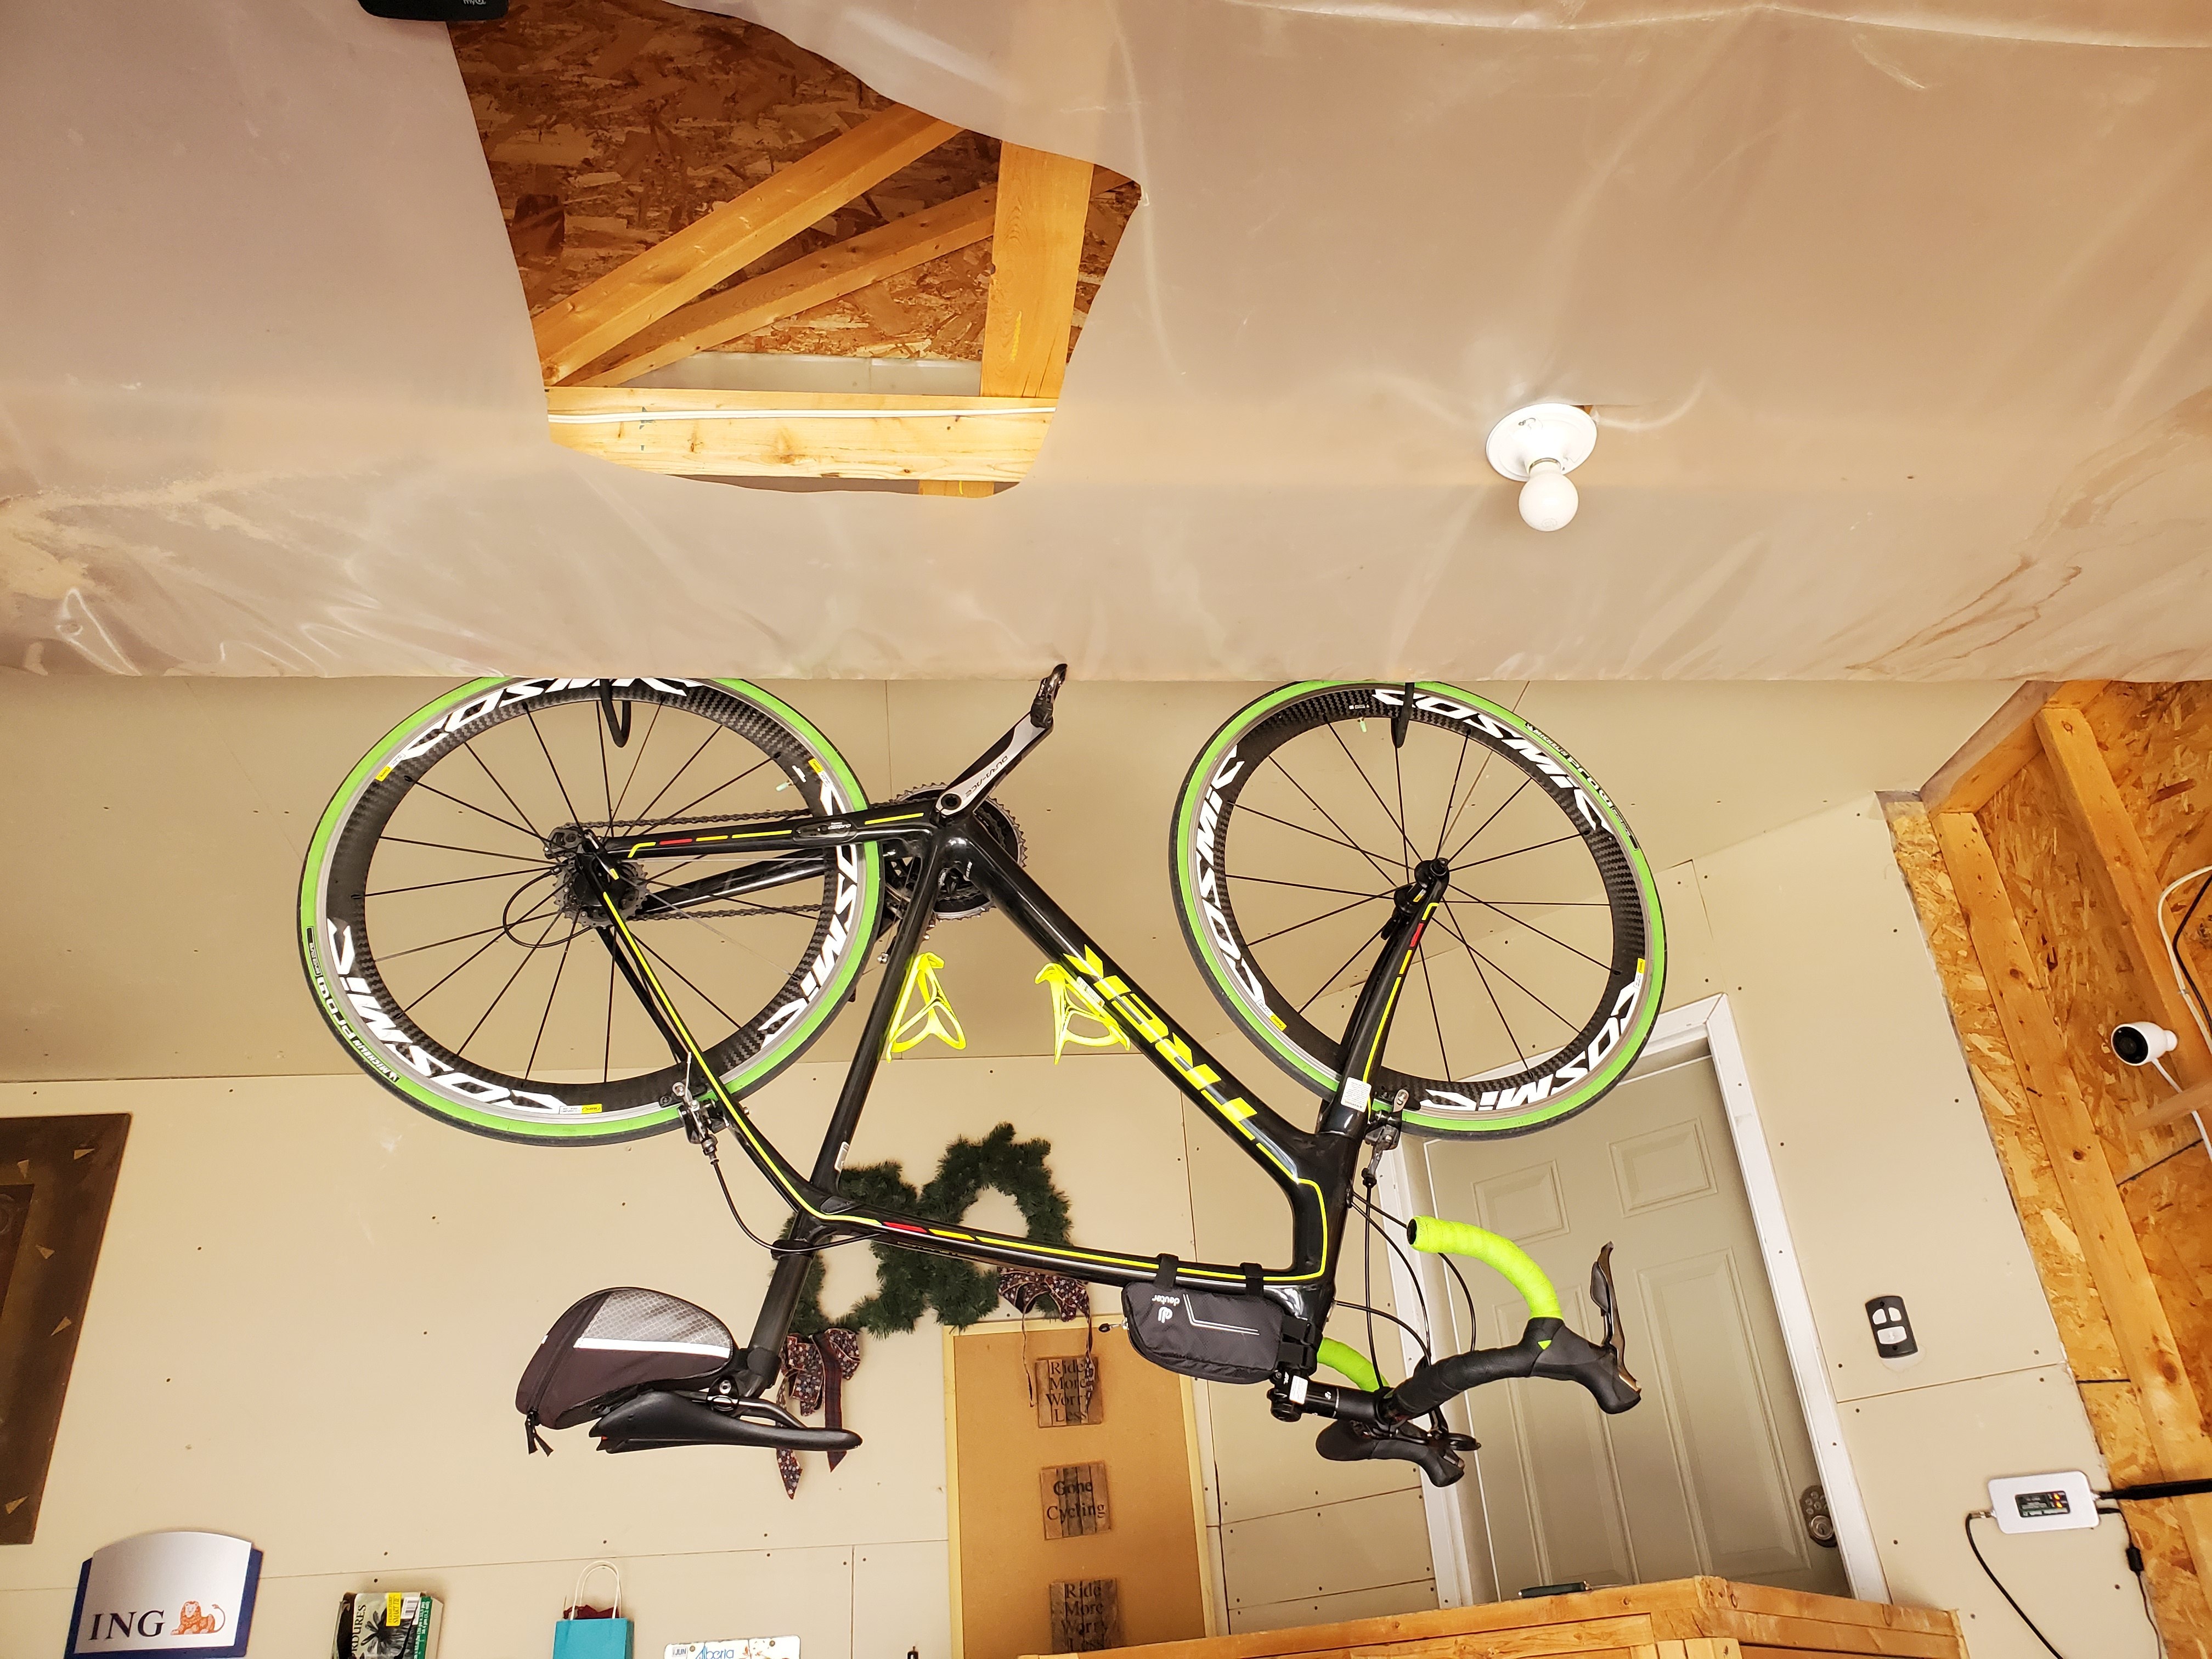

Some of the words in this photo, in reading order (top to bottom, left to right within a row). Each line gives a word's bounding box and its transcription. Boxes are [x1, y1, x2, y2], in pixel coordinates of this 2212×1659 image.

[964, 755, 1008, 797] DURA-ACE
[1062, 944, 1257, 1140] TREK
[352, 1039, 390, 1073] MICHELIN
[1152, 1295, 1180, 1306] deuter
[1051, 1359, 1084, 1374] Ride
[1049, 1378, 1086, 1390] More
[1054, 1409, 1087, 1422] Less
[1053, 1481, 1093, 1496] Gone
[1047, 1500, 1106, 1524] Cycling
[1064, 1582, 1102, 1598] Ride
[1065, 1600, 1104, 1615] More
[89, 1610, 165, 1640] ING
[351, 1604, 366, 1657] RDURES
[696, 1646, 735, 1659] Alberta
